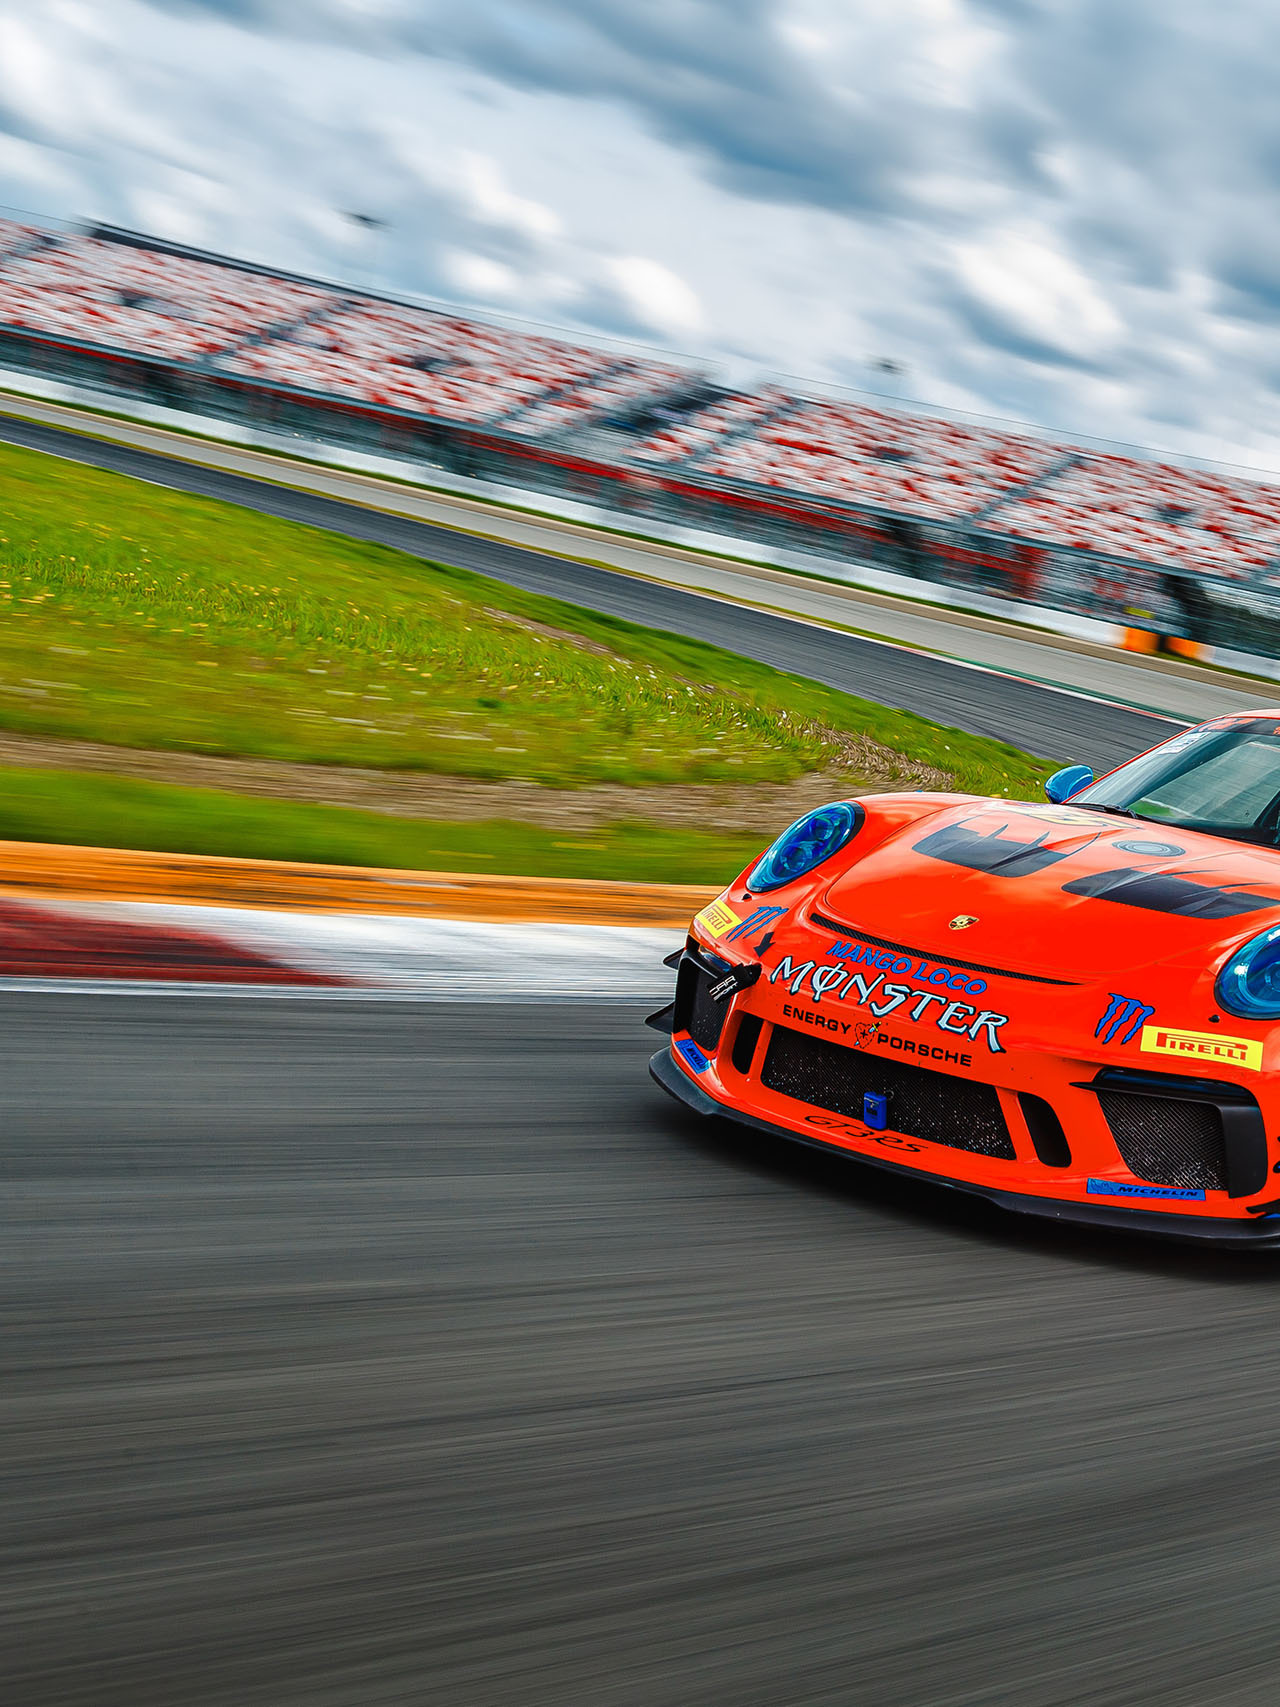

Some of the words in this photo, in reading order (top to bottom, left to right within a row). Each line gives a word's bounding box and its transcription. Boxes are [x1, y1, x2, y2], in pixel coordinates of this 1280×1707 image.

[701, 904, 734, 931] PIRELLI
[826, 940, 911, 975] MANGO
[911, 962, 988, 995] LOCO
[783, 1004, 852, 1036] ENERGY
[877, 1033, 972, 1067] PORSCHE
[1156, 1032, 1249, 1061] PIRELLI
[1118, 1186, 1198, 1197] MICHELIN
